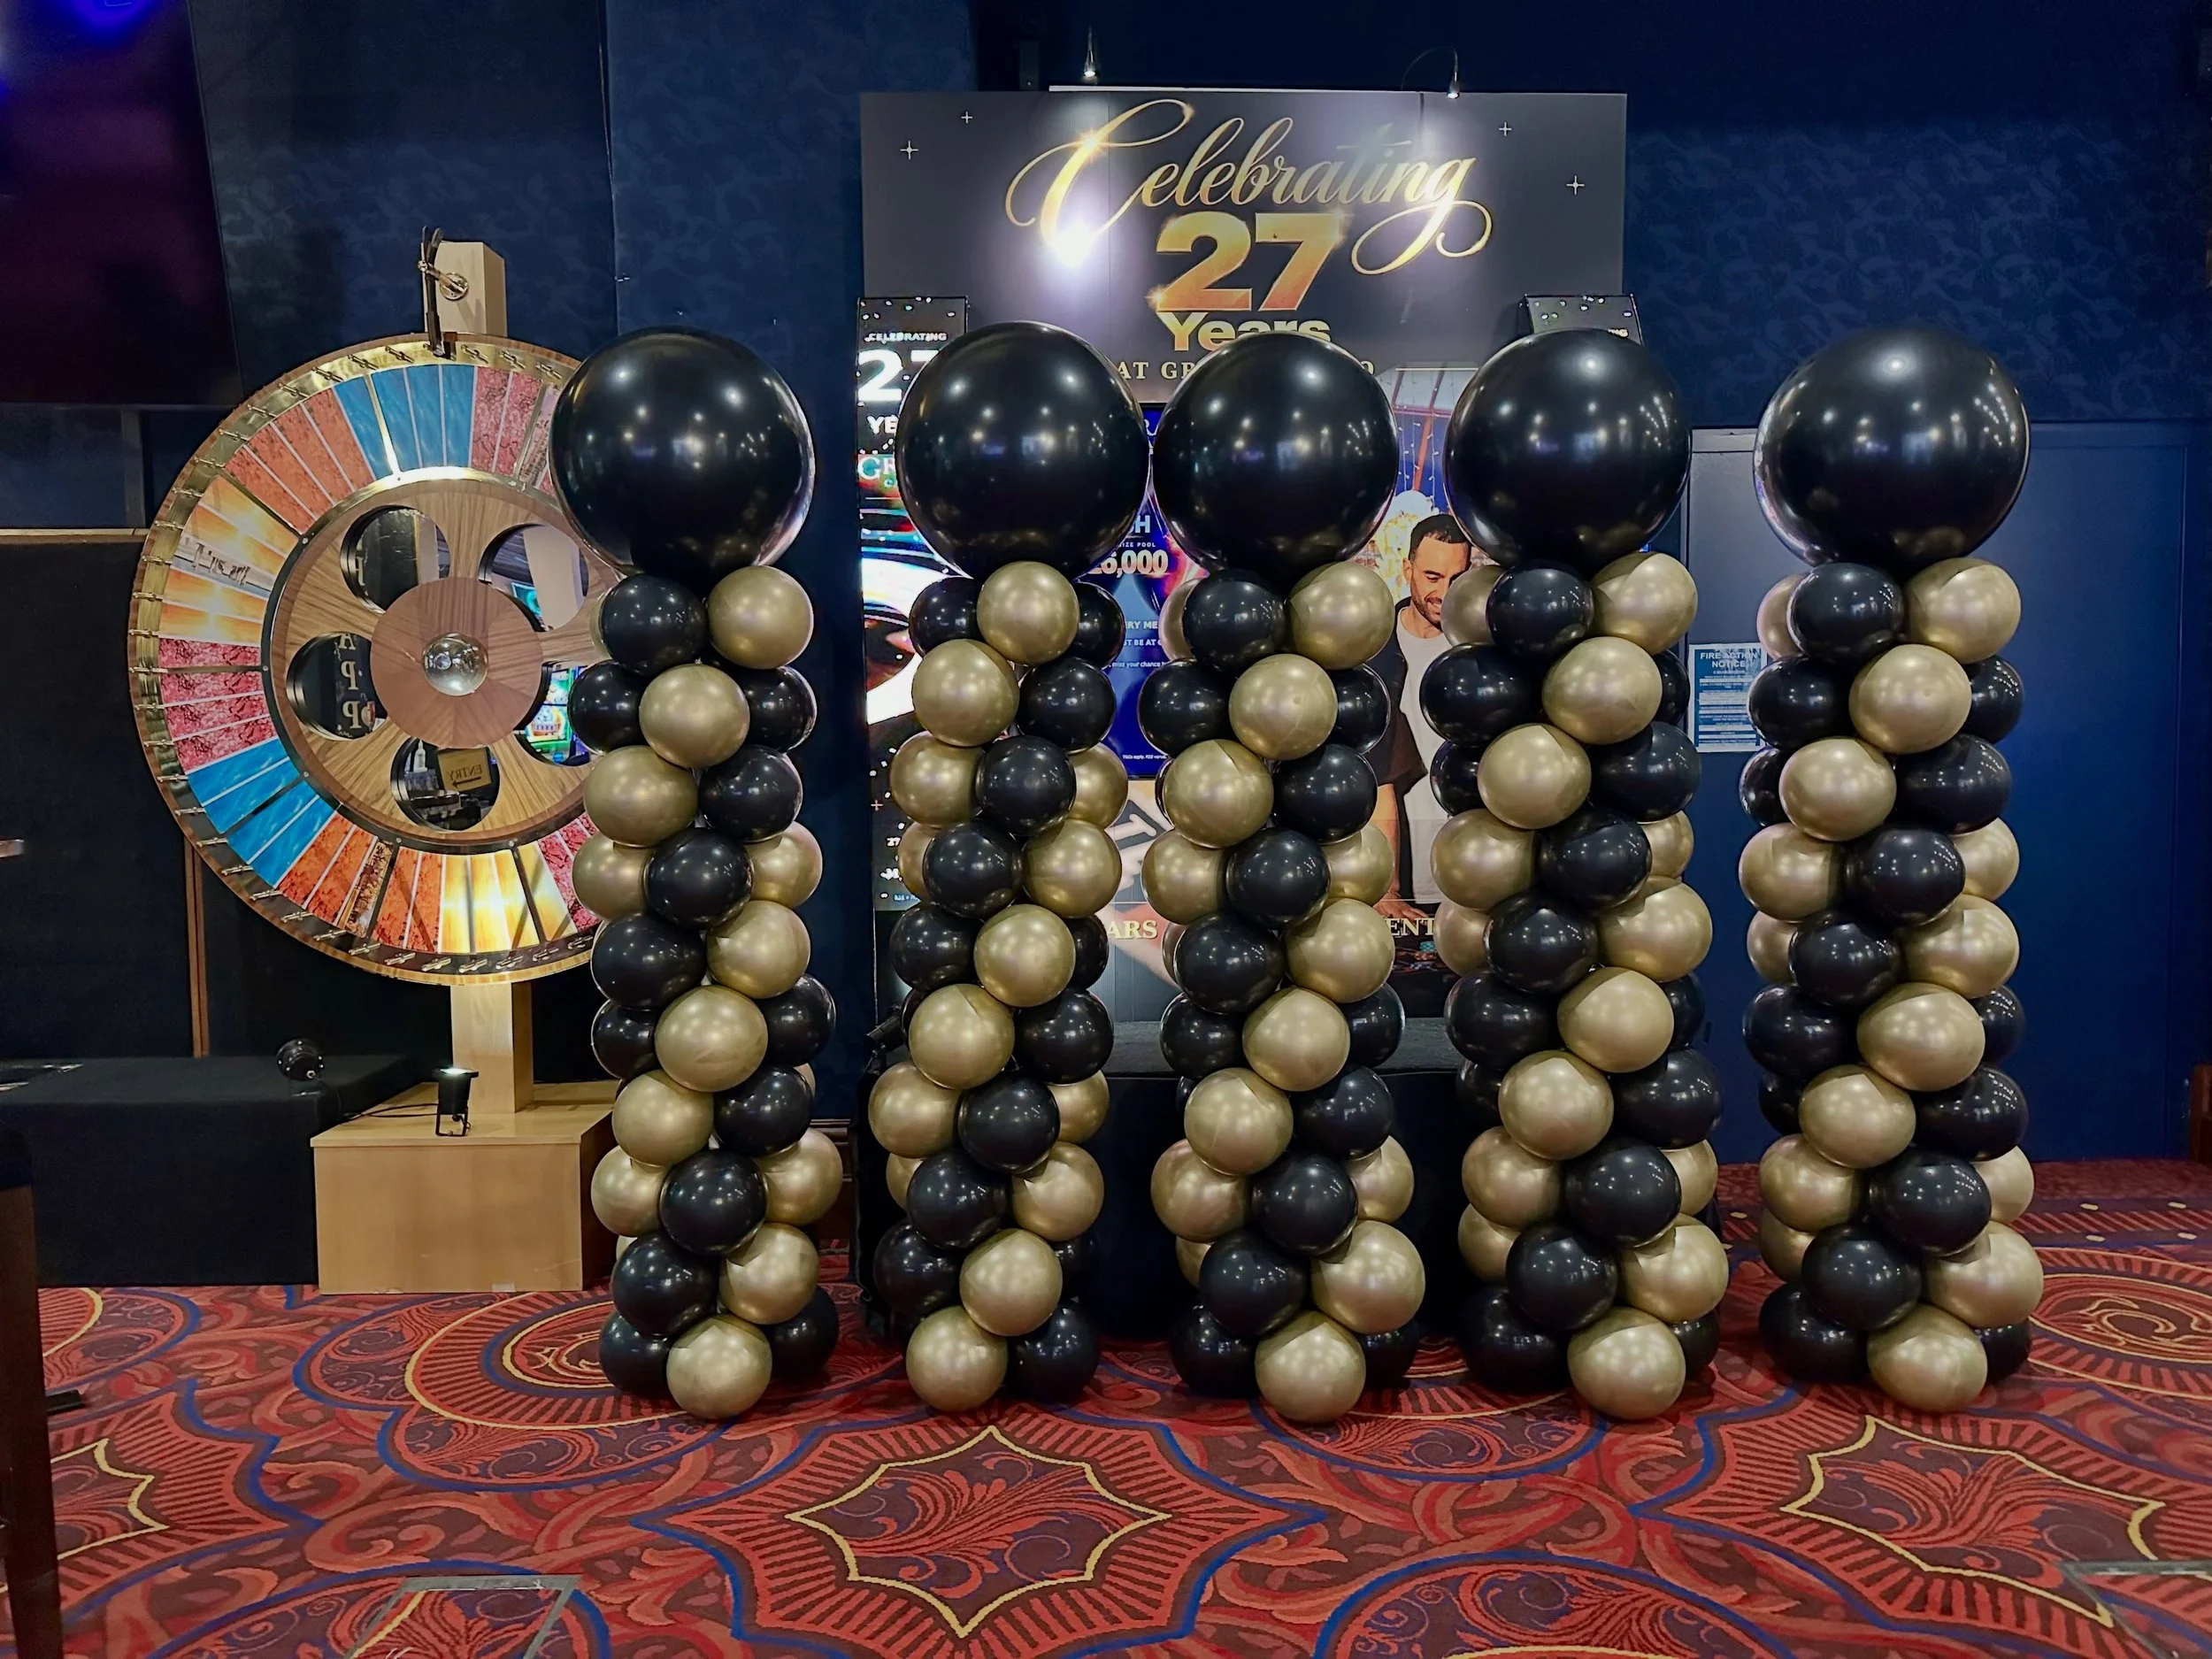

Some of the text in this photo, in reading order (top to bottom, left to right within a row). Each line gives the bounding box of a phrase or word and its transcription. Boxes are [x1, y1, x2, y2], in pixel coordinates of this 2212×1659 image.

[1005, 99, 1493, 275] Celebrating
[1156, 211, 1343, 311] 27
[867, 332, 948, 342] CELEBRATING
[1117, 361, 1149, 380] AT
